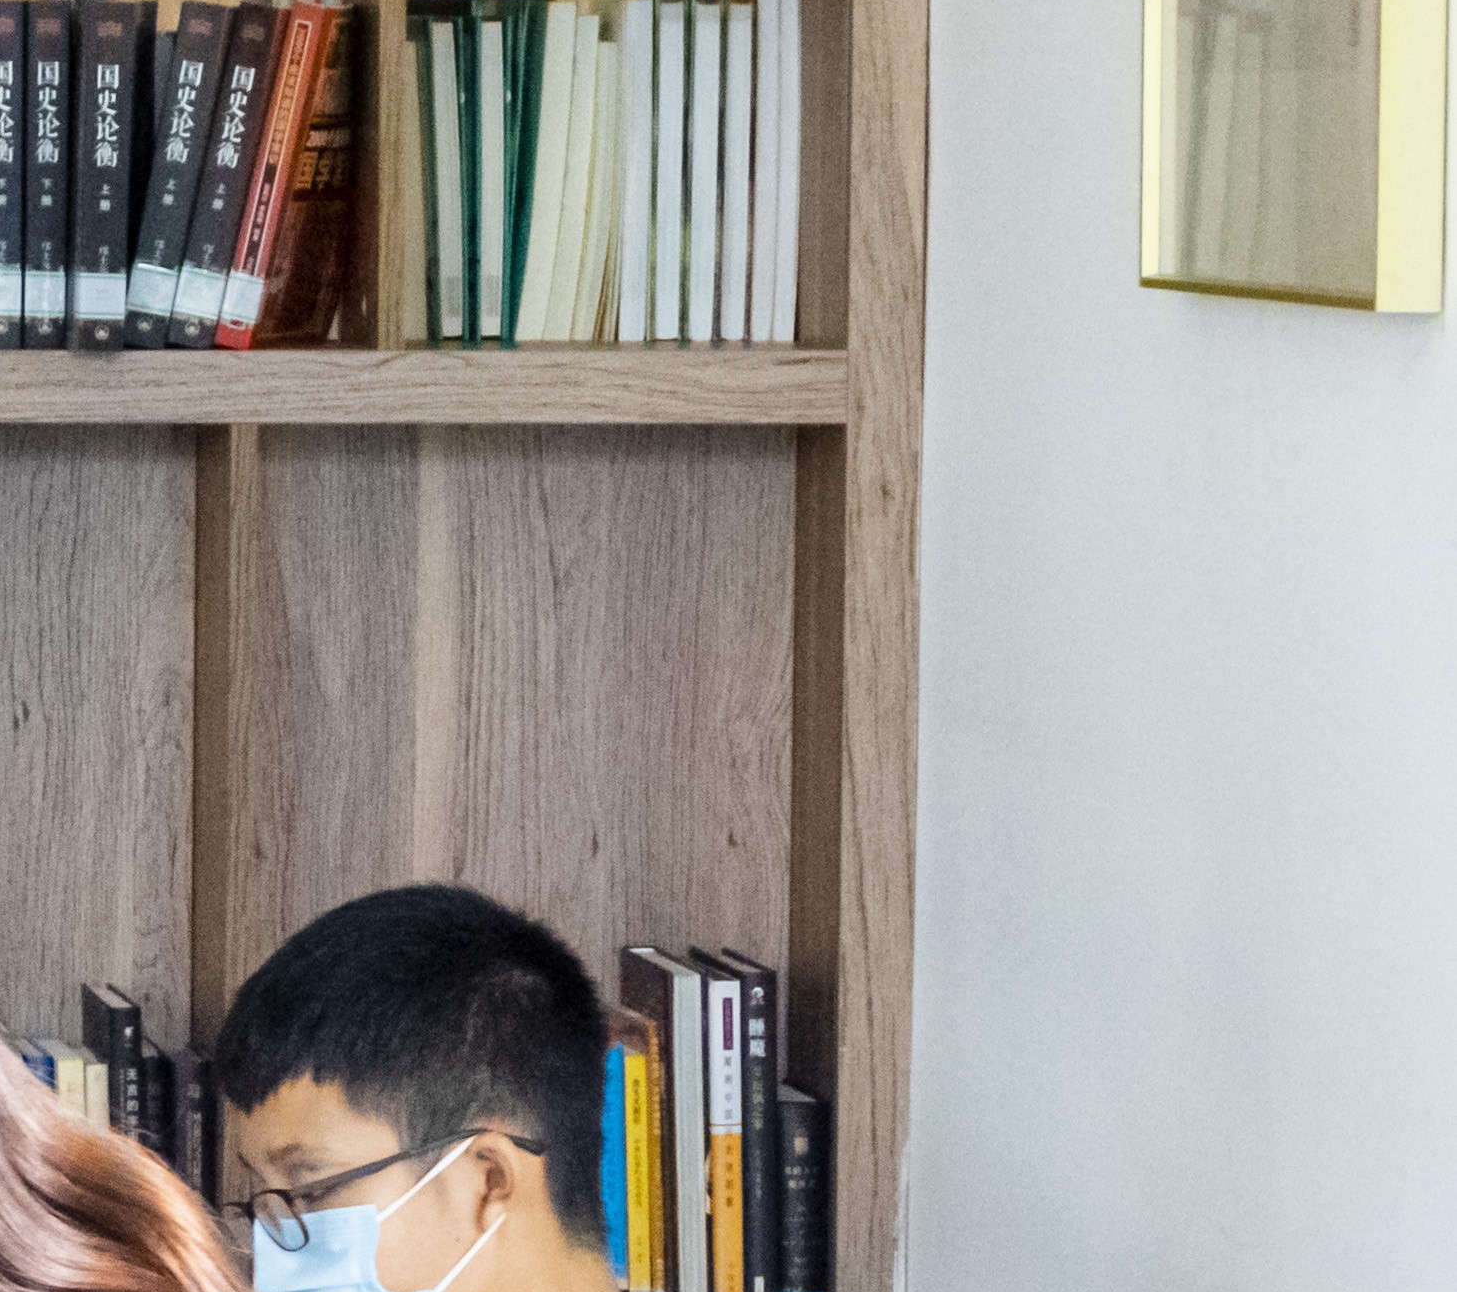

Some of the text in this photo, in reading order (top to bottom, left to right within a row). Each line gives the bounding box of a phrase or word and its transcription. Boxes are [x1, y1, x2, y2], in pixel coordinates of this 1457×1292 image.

[36, 61, 60, 163] 国史论衡
[94, 64, 120, 167] 国史论衡
[166, 60, 204, 164] 国史论衡
[217, 65, 255, 168] 国史论衡
